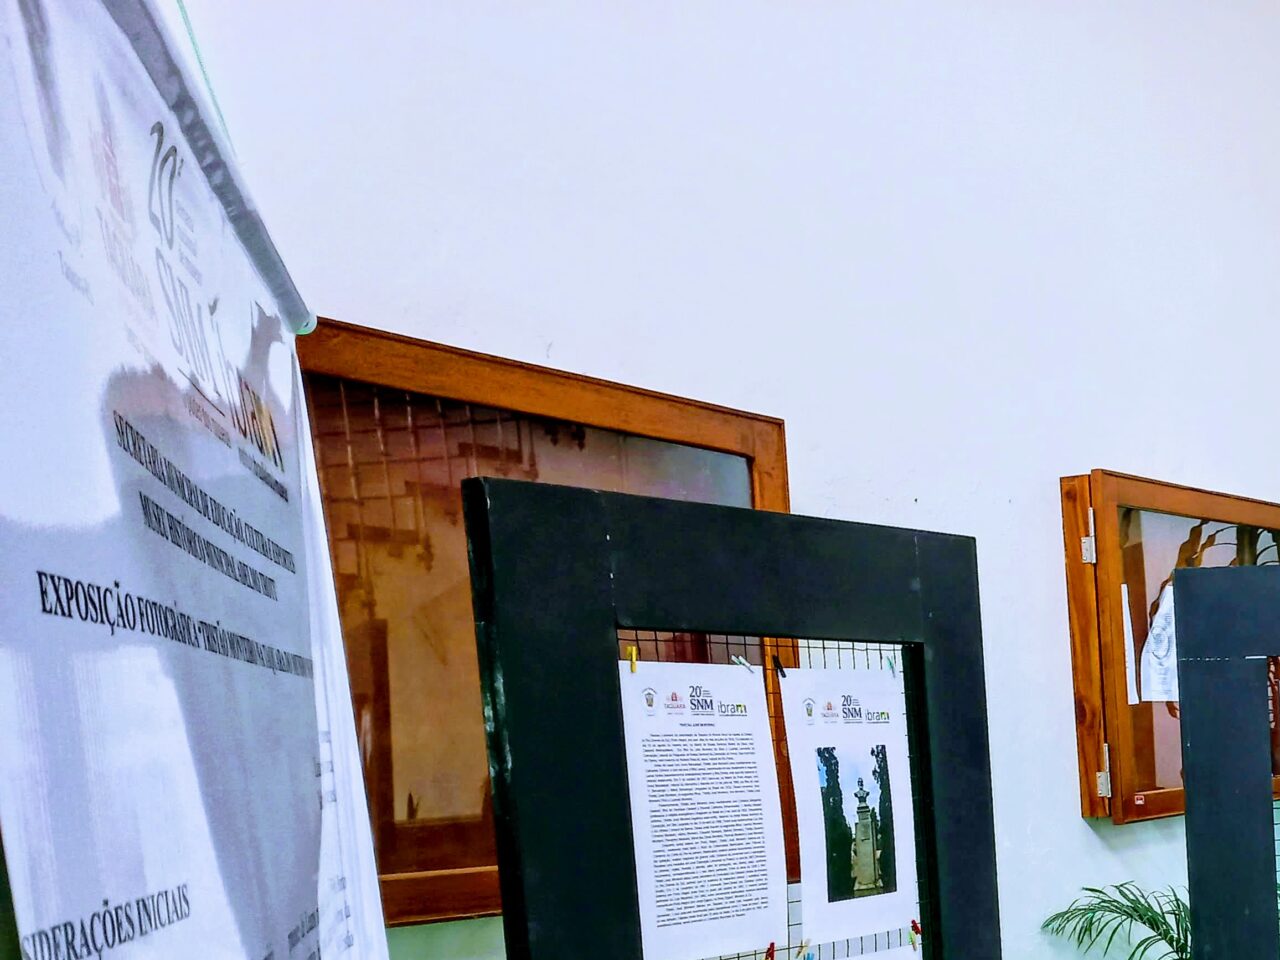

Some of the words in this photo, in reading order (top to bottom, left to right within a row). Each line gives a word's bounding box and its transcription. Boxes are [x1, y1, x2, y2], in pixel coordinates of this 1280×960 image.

[36, 570, 136, 636] EXPOSIÇÃO
[136, 597, 200, 649] FOTOGRÁFICA
[690, 698, 714, 710] SNM
[718, 702, 747, 713] ibram
[842, 708, 862, 718] SNM
[866, 709, 889, 720] ibram
[136, 884, 190, 937] INICIAIS
